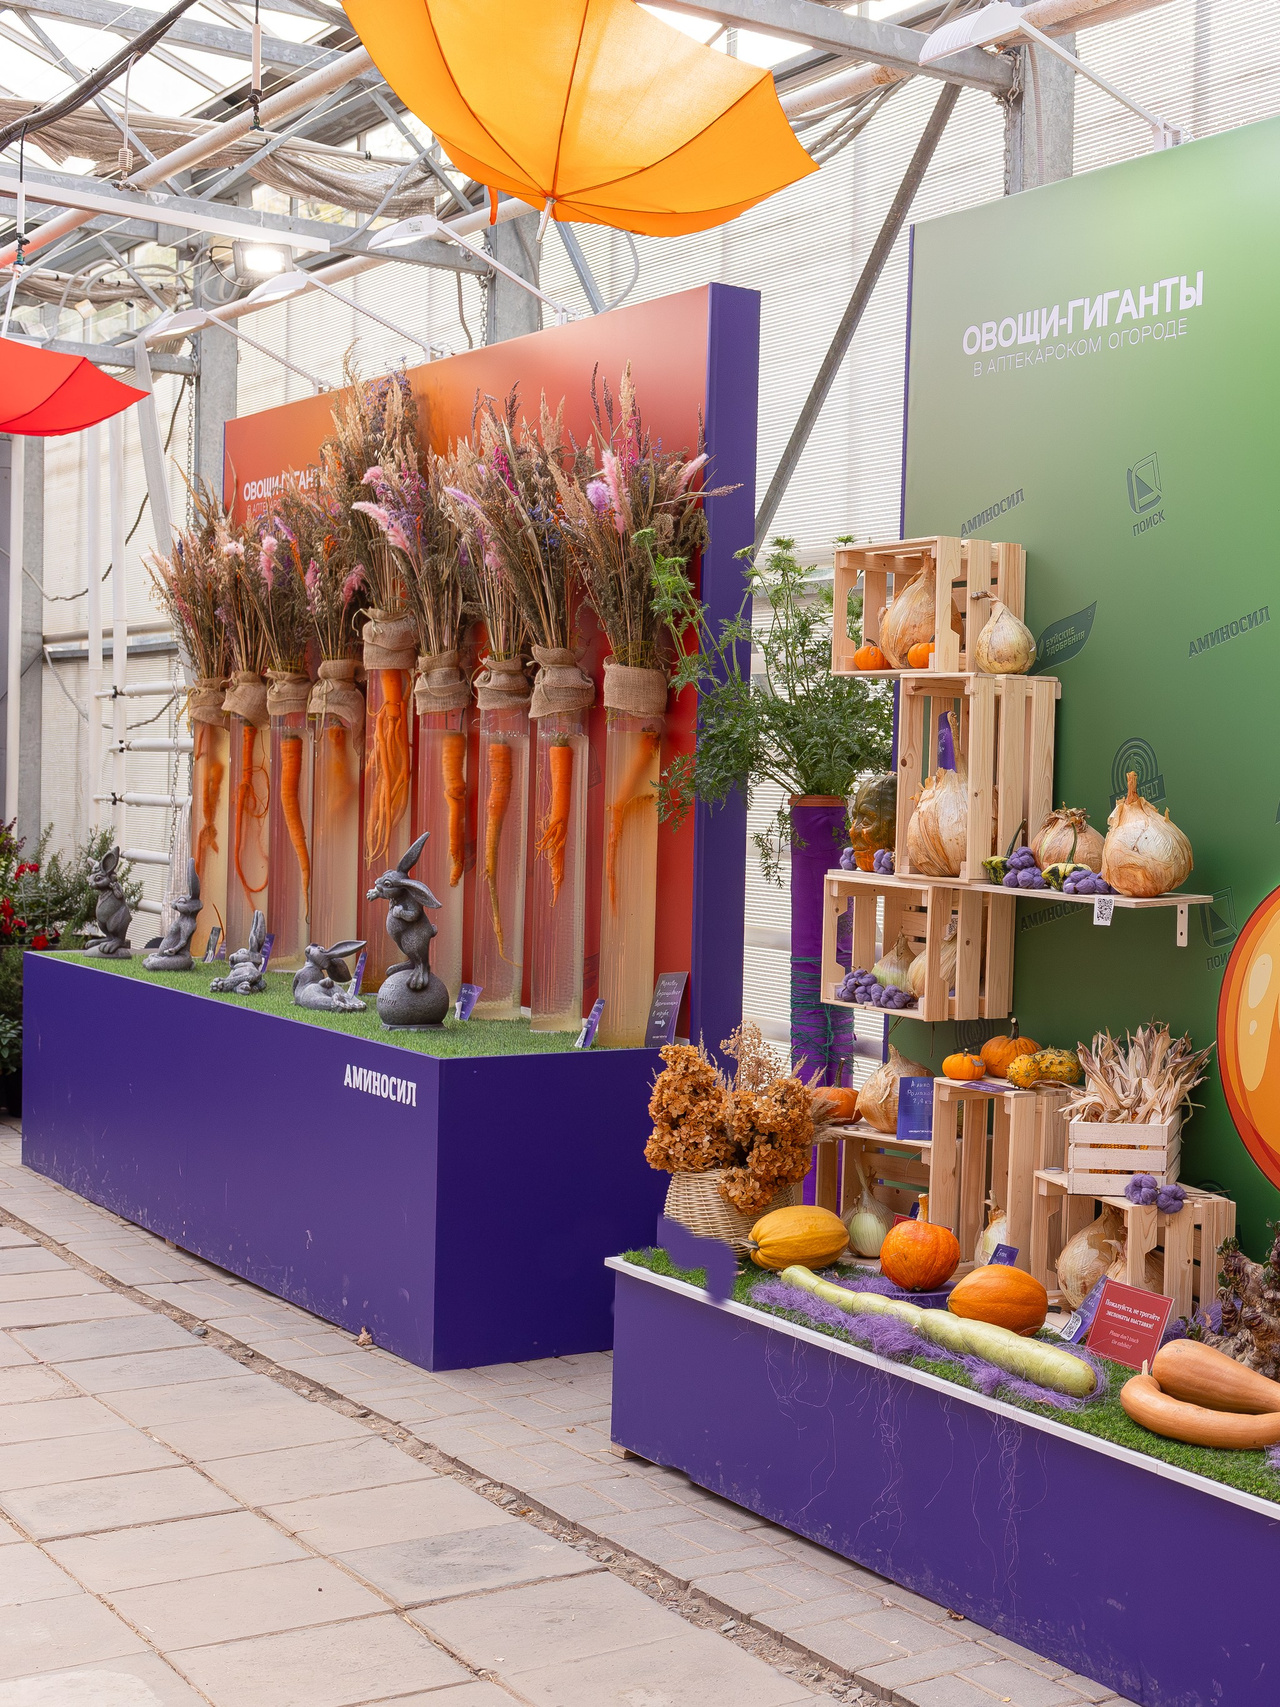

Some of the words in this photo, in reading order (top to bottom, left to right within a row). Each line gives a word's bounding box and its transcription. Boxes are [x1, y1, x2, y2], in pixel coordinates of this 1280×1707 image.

[962, 270, 1204, 355] ОВОЩИ-ГИГАНТЫ
[973, 361, 982, 377] В
[986, 336, 1102, 374] АПТЕКАРСКОМ
[1108, 317, 1188, 349] ОГОРОДЕ
[960, 488, 1025, 537] АМИНОСИЛ
[1133, 509, 1166, 537] ПОИСК
[1046, 626, 1076, 647] БУЙСКИЕ
[1046, 630, 1085, 657] УДОБРЕНИЯ
[1188, 605, 1271, 659] АМИНОСИЛ
[344, 1063, 417, 1107] АМИНОСИЛ
